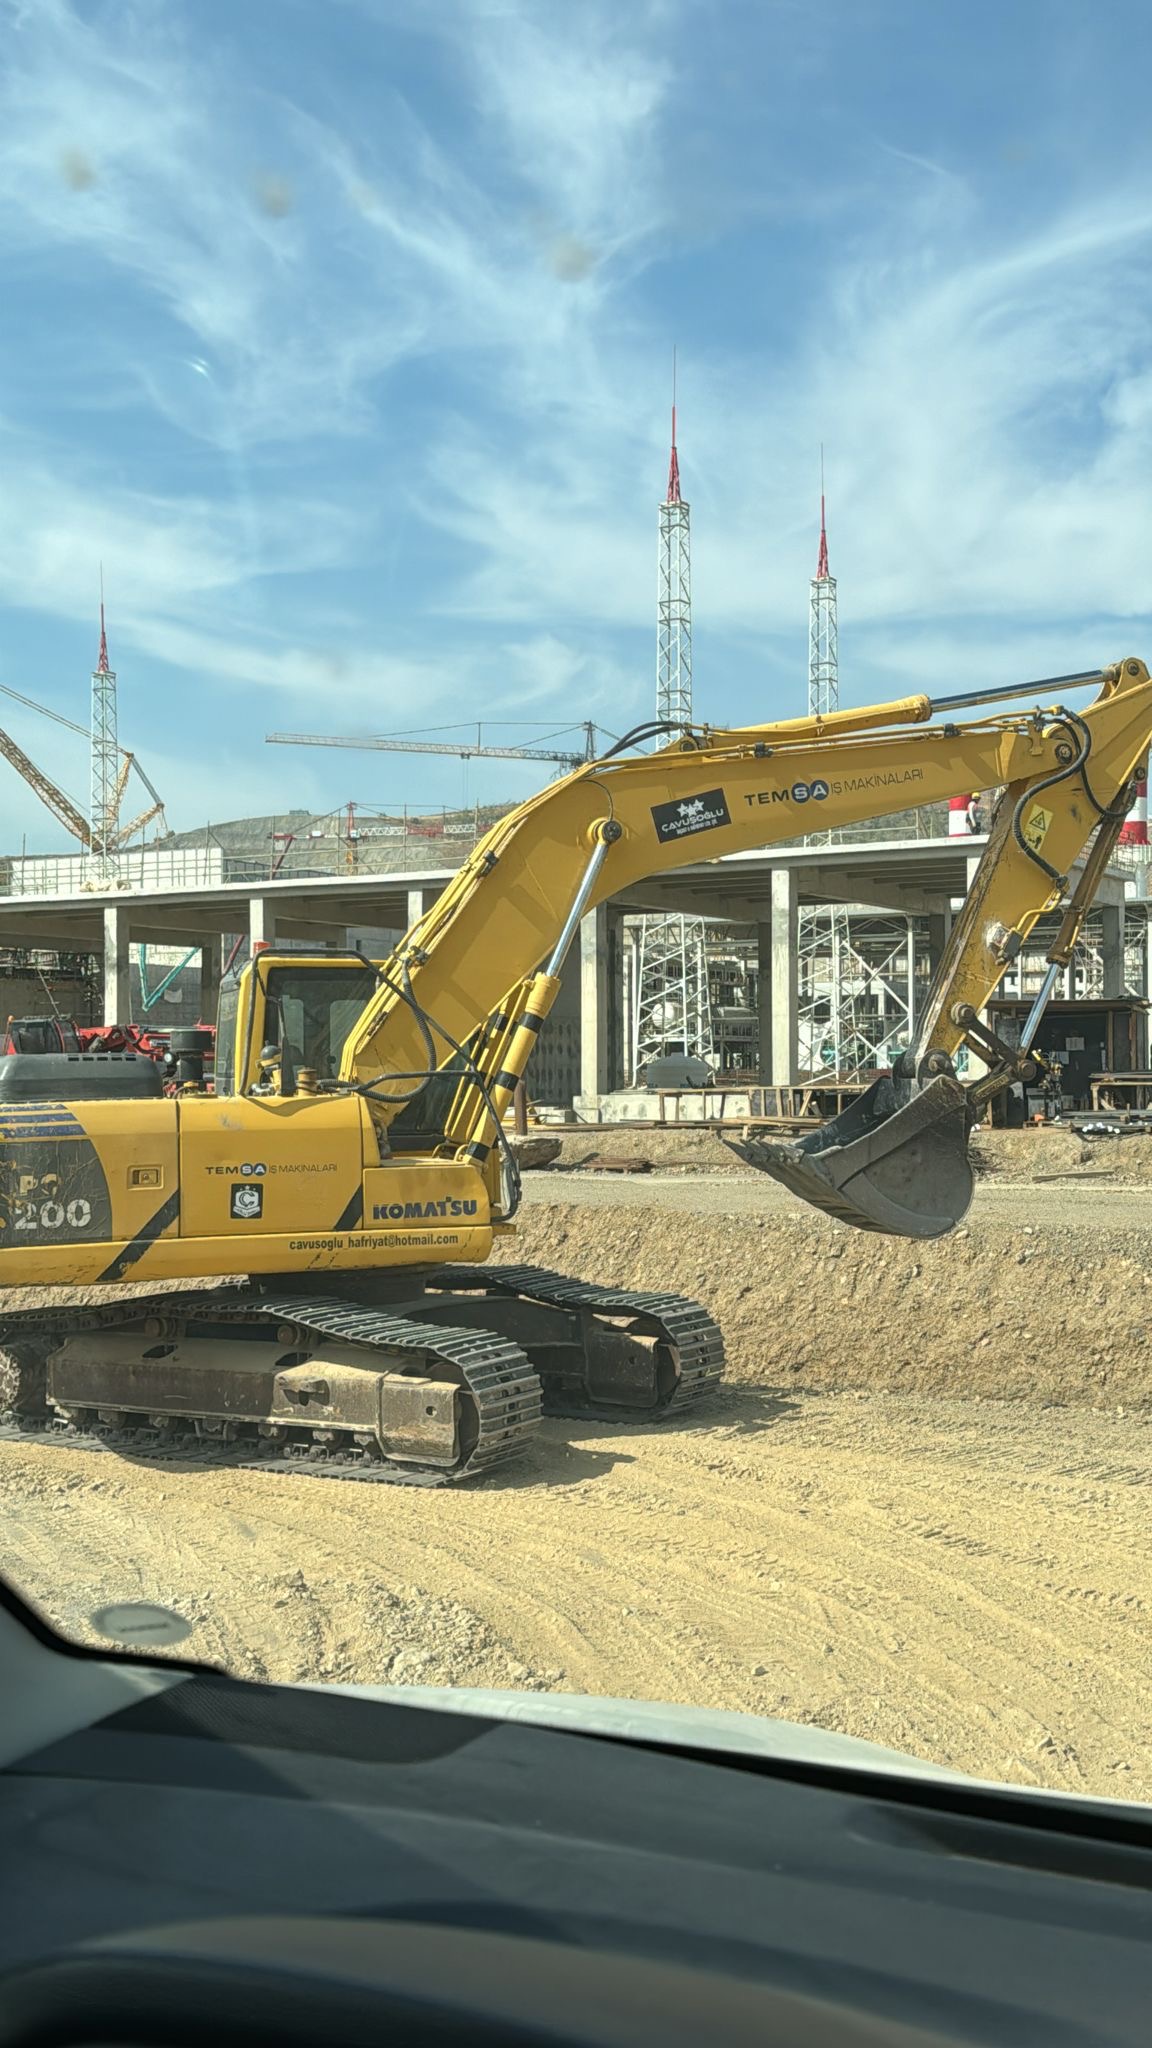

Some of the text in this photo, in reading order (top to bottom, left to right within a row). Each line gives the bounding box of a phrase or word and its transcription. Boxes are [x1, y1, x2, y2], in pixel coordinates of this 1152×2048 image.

[743, 779, 829, 806] TEMSA
[205, 1163, 267, 1176] TEMSA
[14, 1199, 91, 1229] 200
[372, 1196, 477, 1220] KOMATSU
